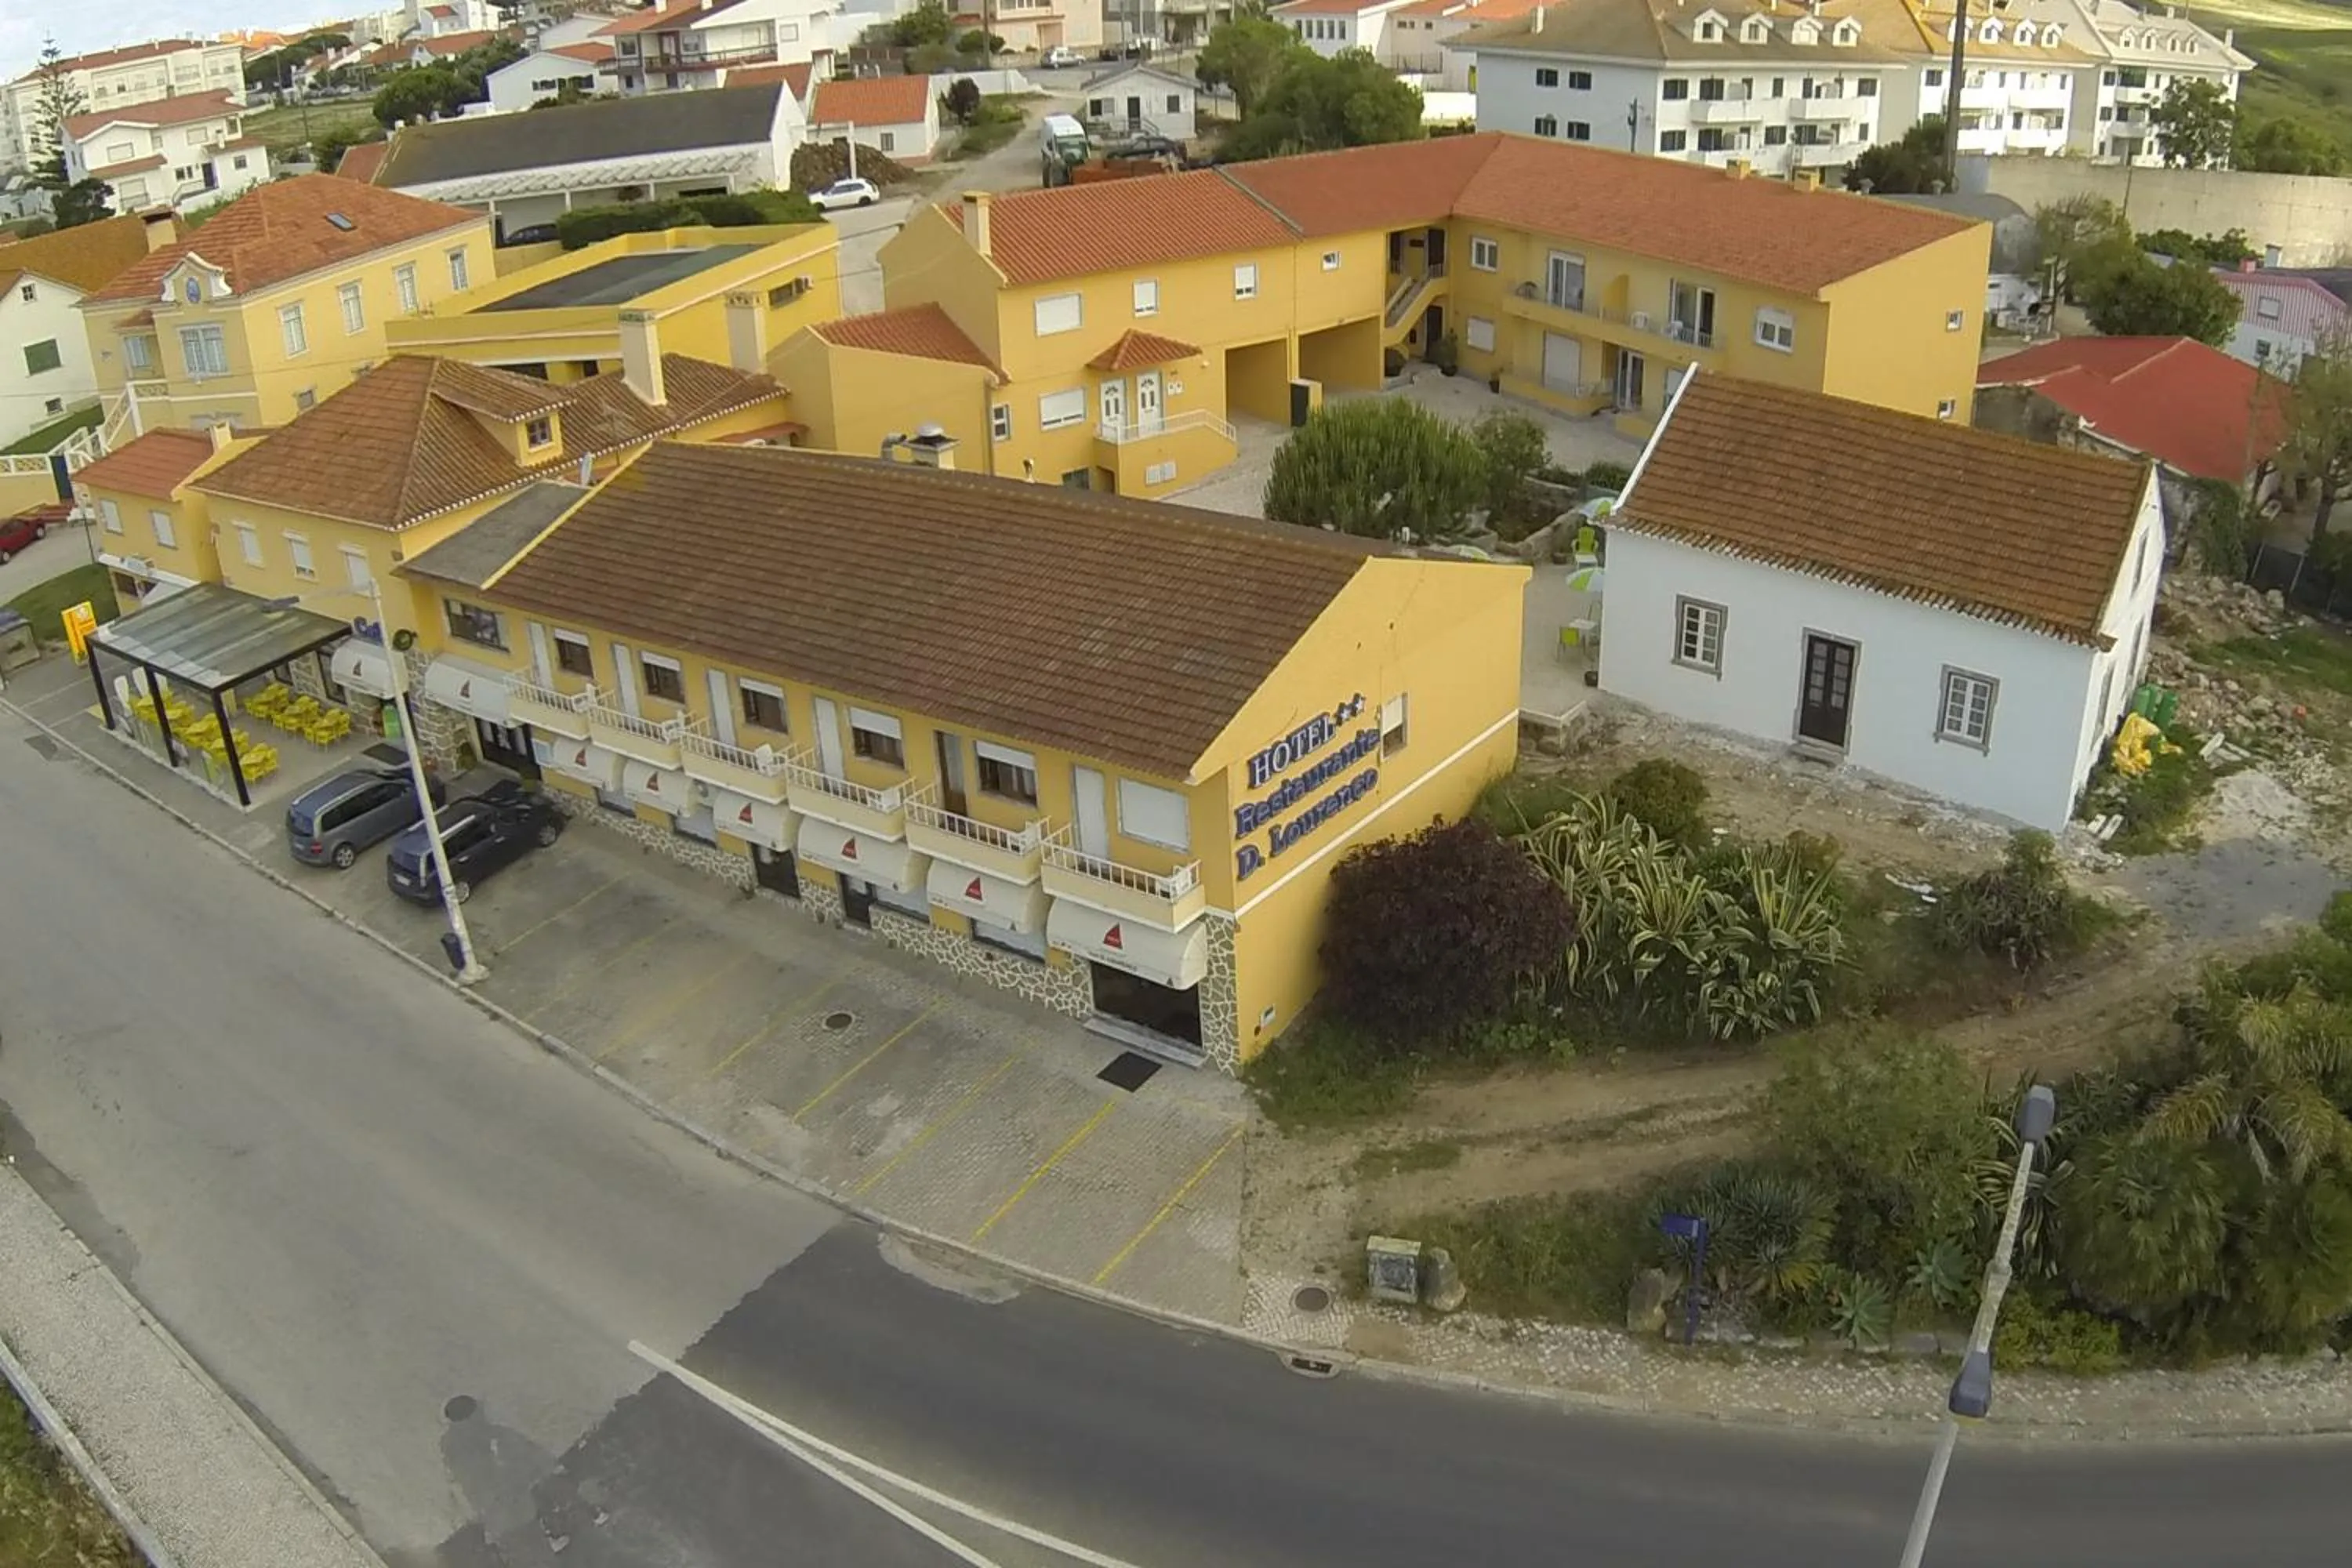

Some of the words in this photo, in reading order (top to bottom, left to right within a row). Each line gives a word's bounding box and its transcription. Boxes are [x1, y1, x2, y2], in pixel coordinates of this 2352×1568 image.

[1234, 728, 1380, 840] Restaurante
[1247, 712, 1336, 789] HOTEL
[1236, 844, 1265, 882] D.
